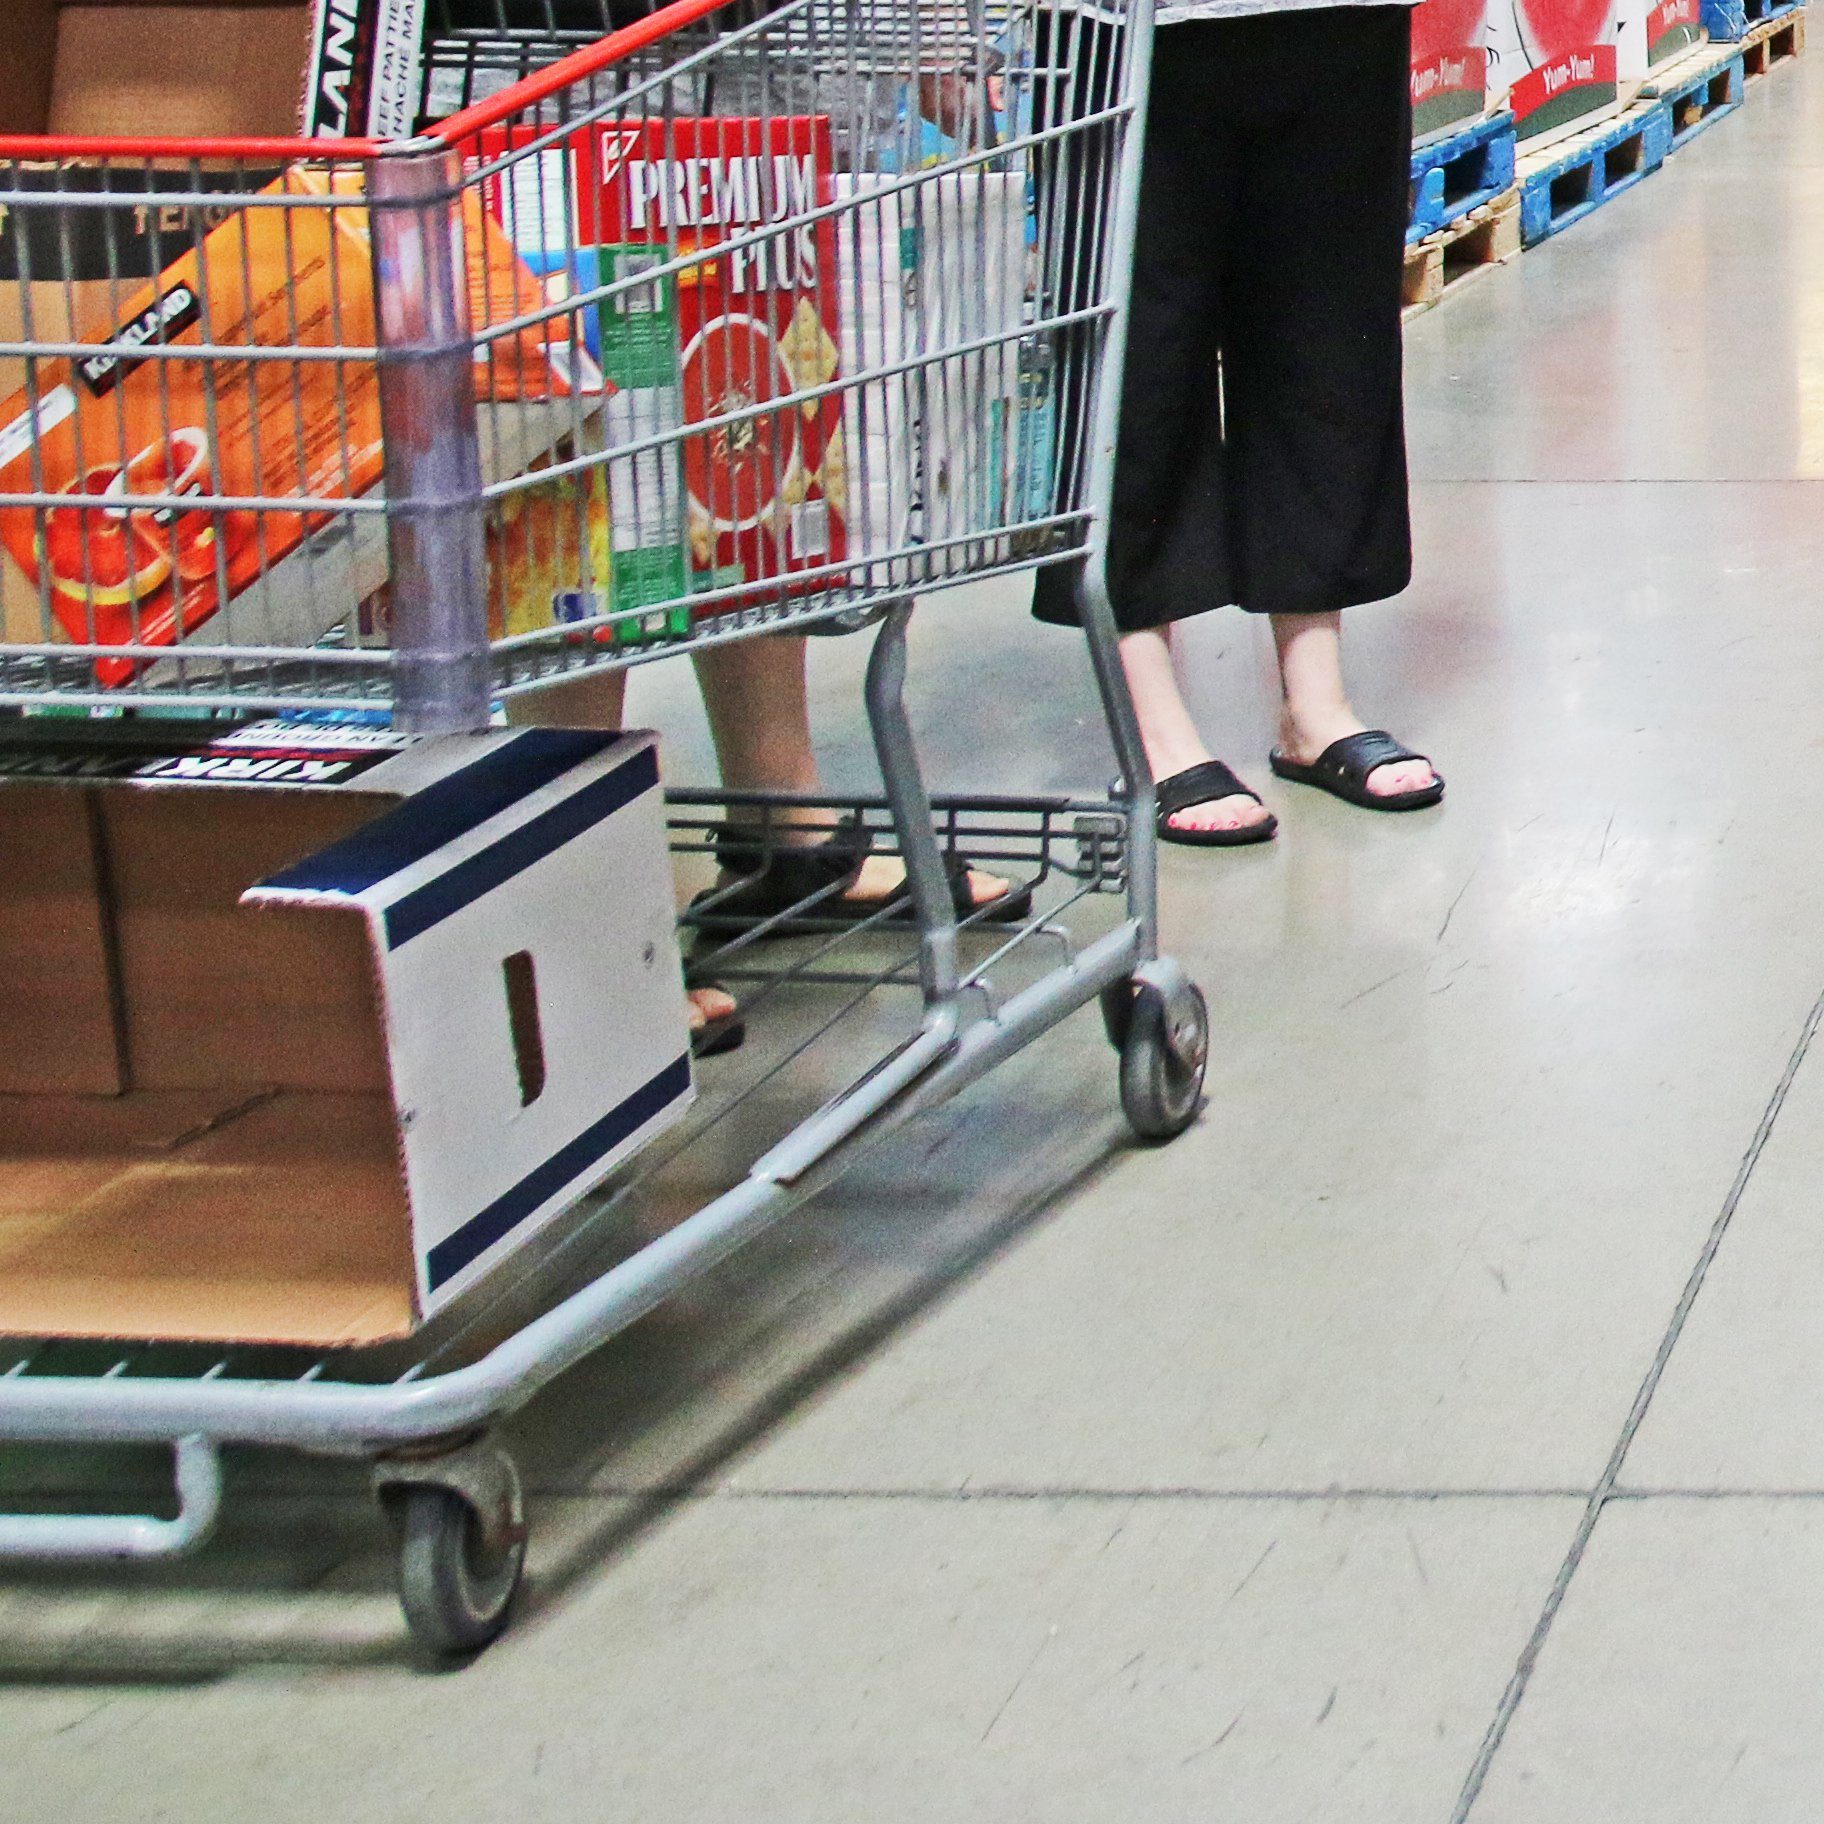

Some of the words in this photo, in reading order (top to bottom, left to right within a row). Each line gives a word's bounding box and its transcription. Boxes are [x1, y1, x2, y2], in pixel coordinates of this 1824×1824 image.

[1543, 54, 1595, 94] Yum-Yum!
[378, 92, 389, 136] EEF
[630, 152, 815, 230] PREMIUM
[729, 225, 817, 294] PLUS
